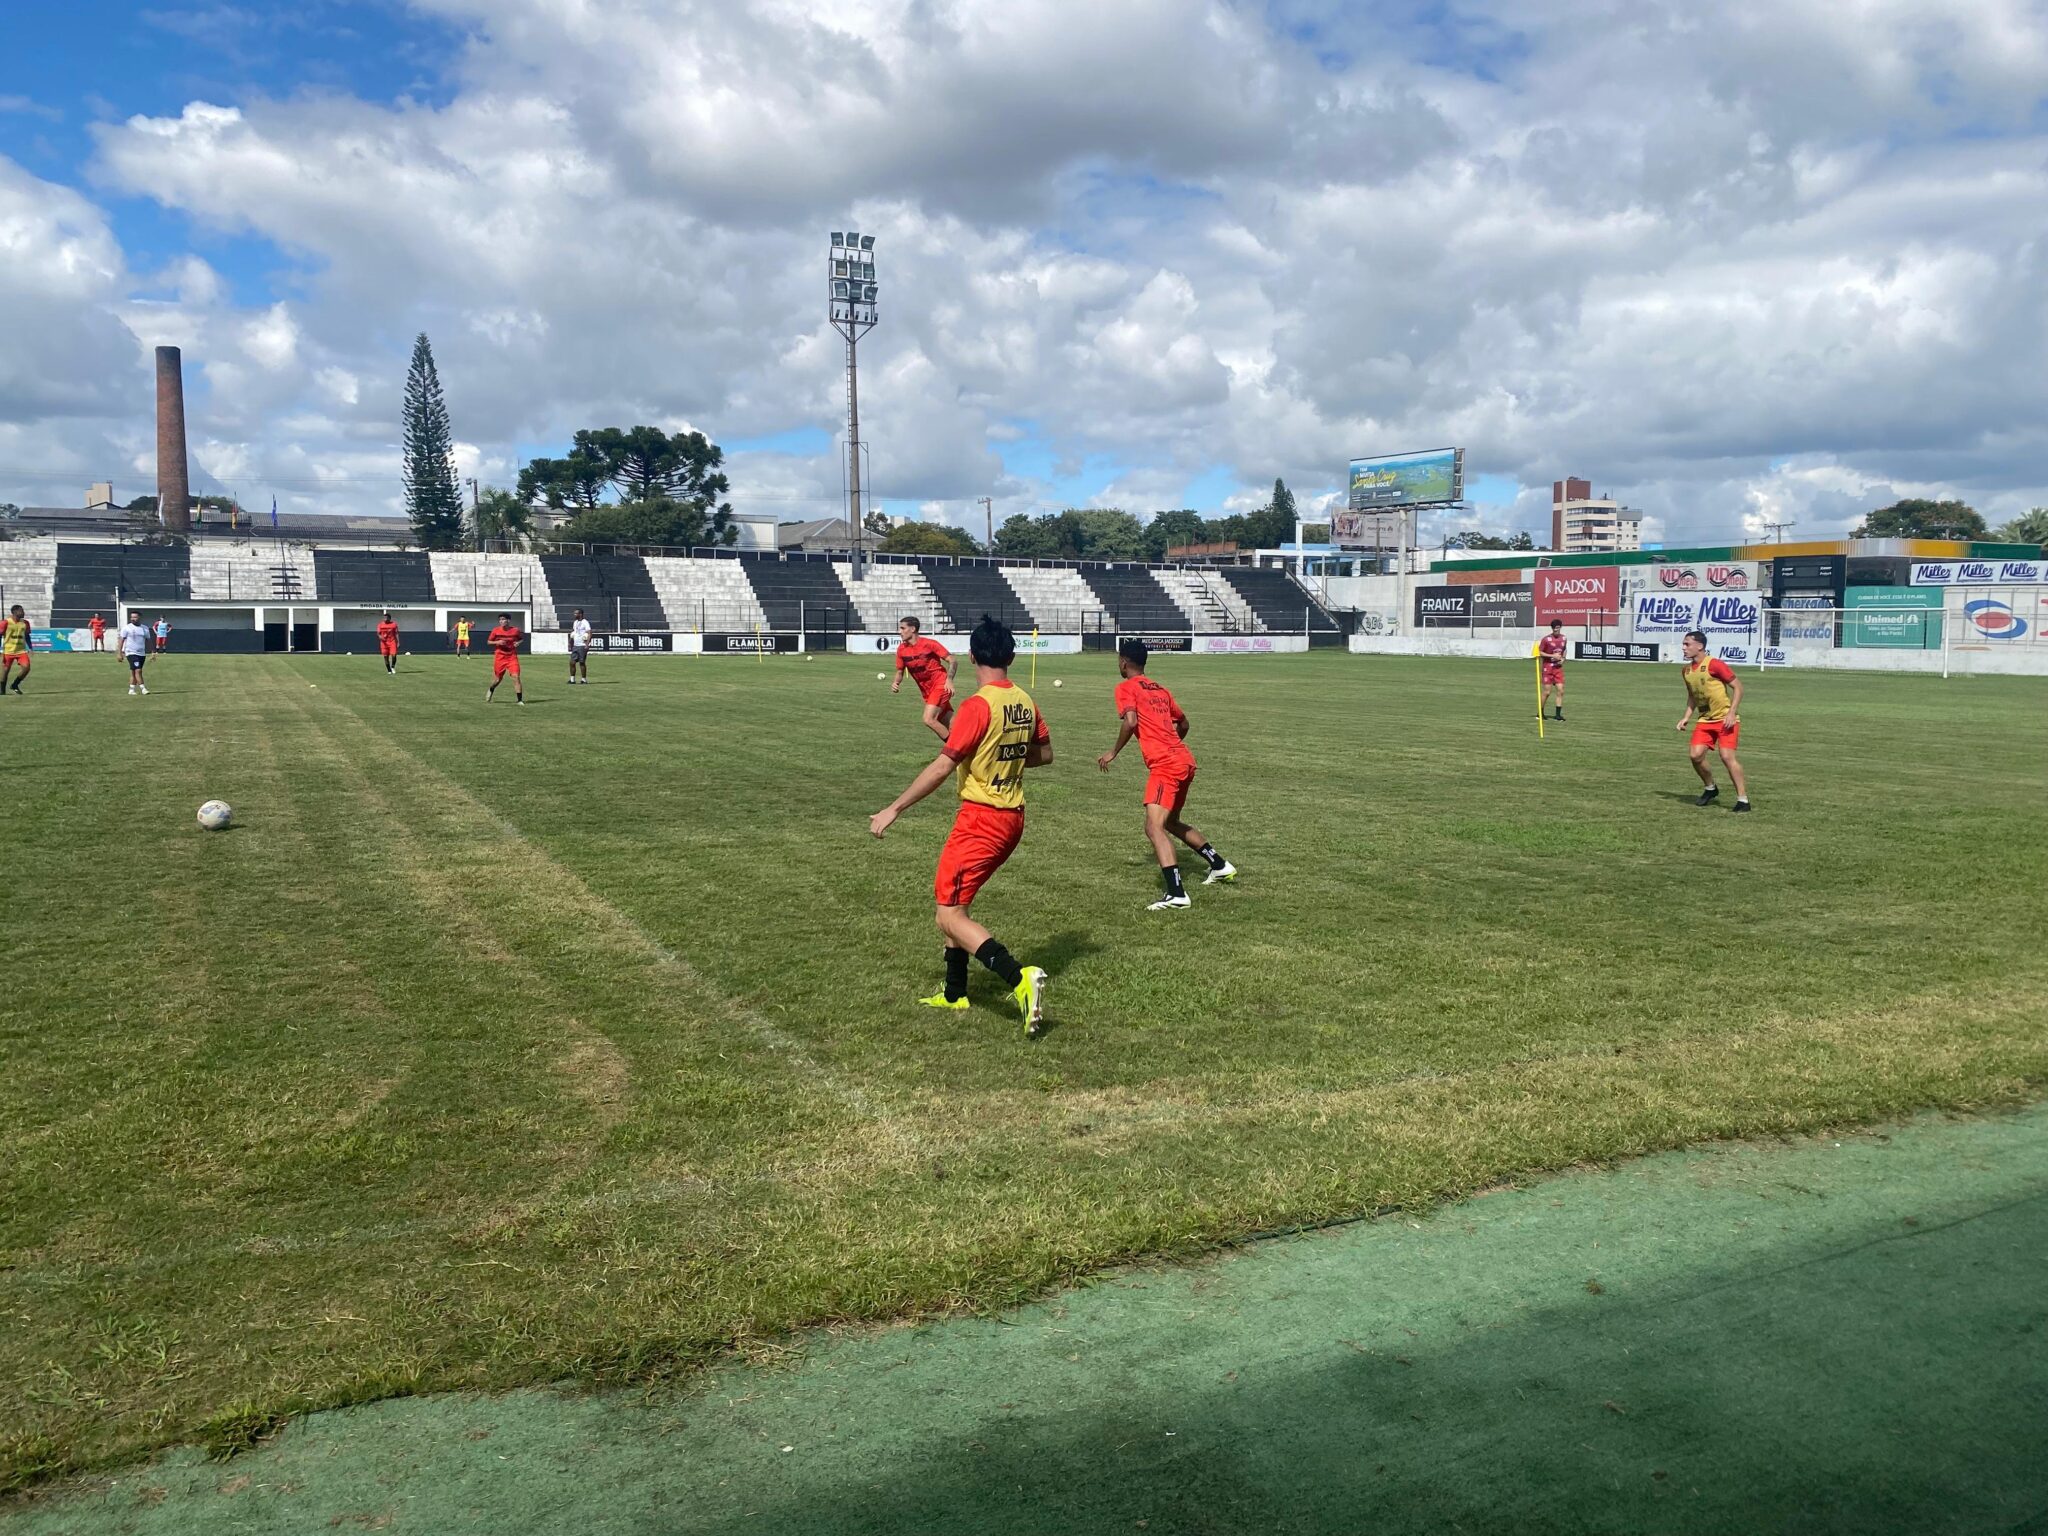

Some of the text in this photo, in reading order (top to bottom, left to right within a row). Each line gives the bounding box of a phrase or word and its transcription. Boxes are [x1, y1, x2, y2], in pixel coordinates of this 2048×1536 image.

[1660, 568, 1681, 581] MD
[1707, 567, 1730, 581] MD
[1917, 565, 1951, 579] Miller
[1957, 564, 1993, 578] Miller
[2000, 563, 2038, 578] Miller
[1554, 578, 1605, 594] RADSON
[1421, 598, 1464, 611] FRANTZ
[1637, 598, 1692, 624] Miller
[1697, 597, 1758, 624] Miller
[1864, 614, 1904, 623] Unimed
[1697, 625, 1757, 634] Supermercados
[1719, 646, 1747, 659] Miller
[1003, 703, 1033, 727] Miller
